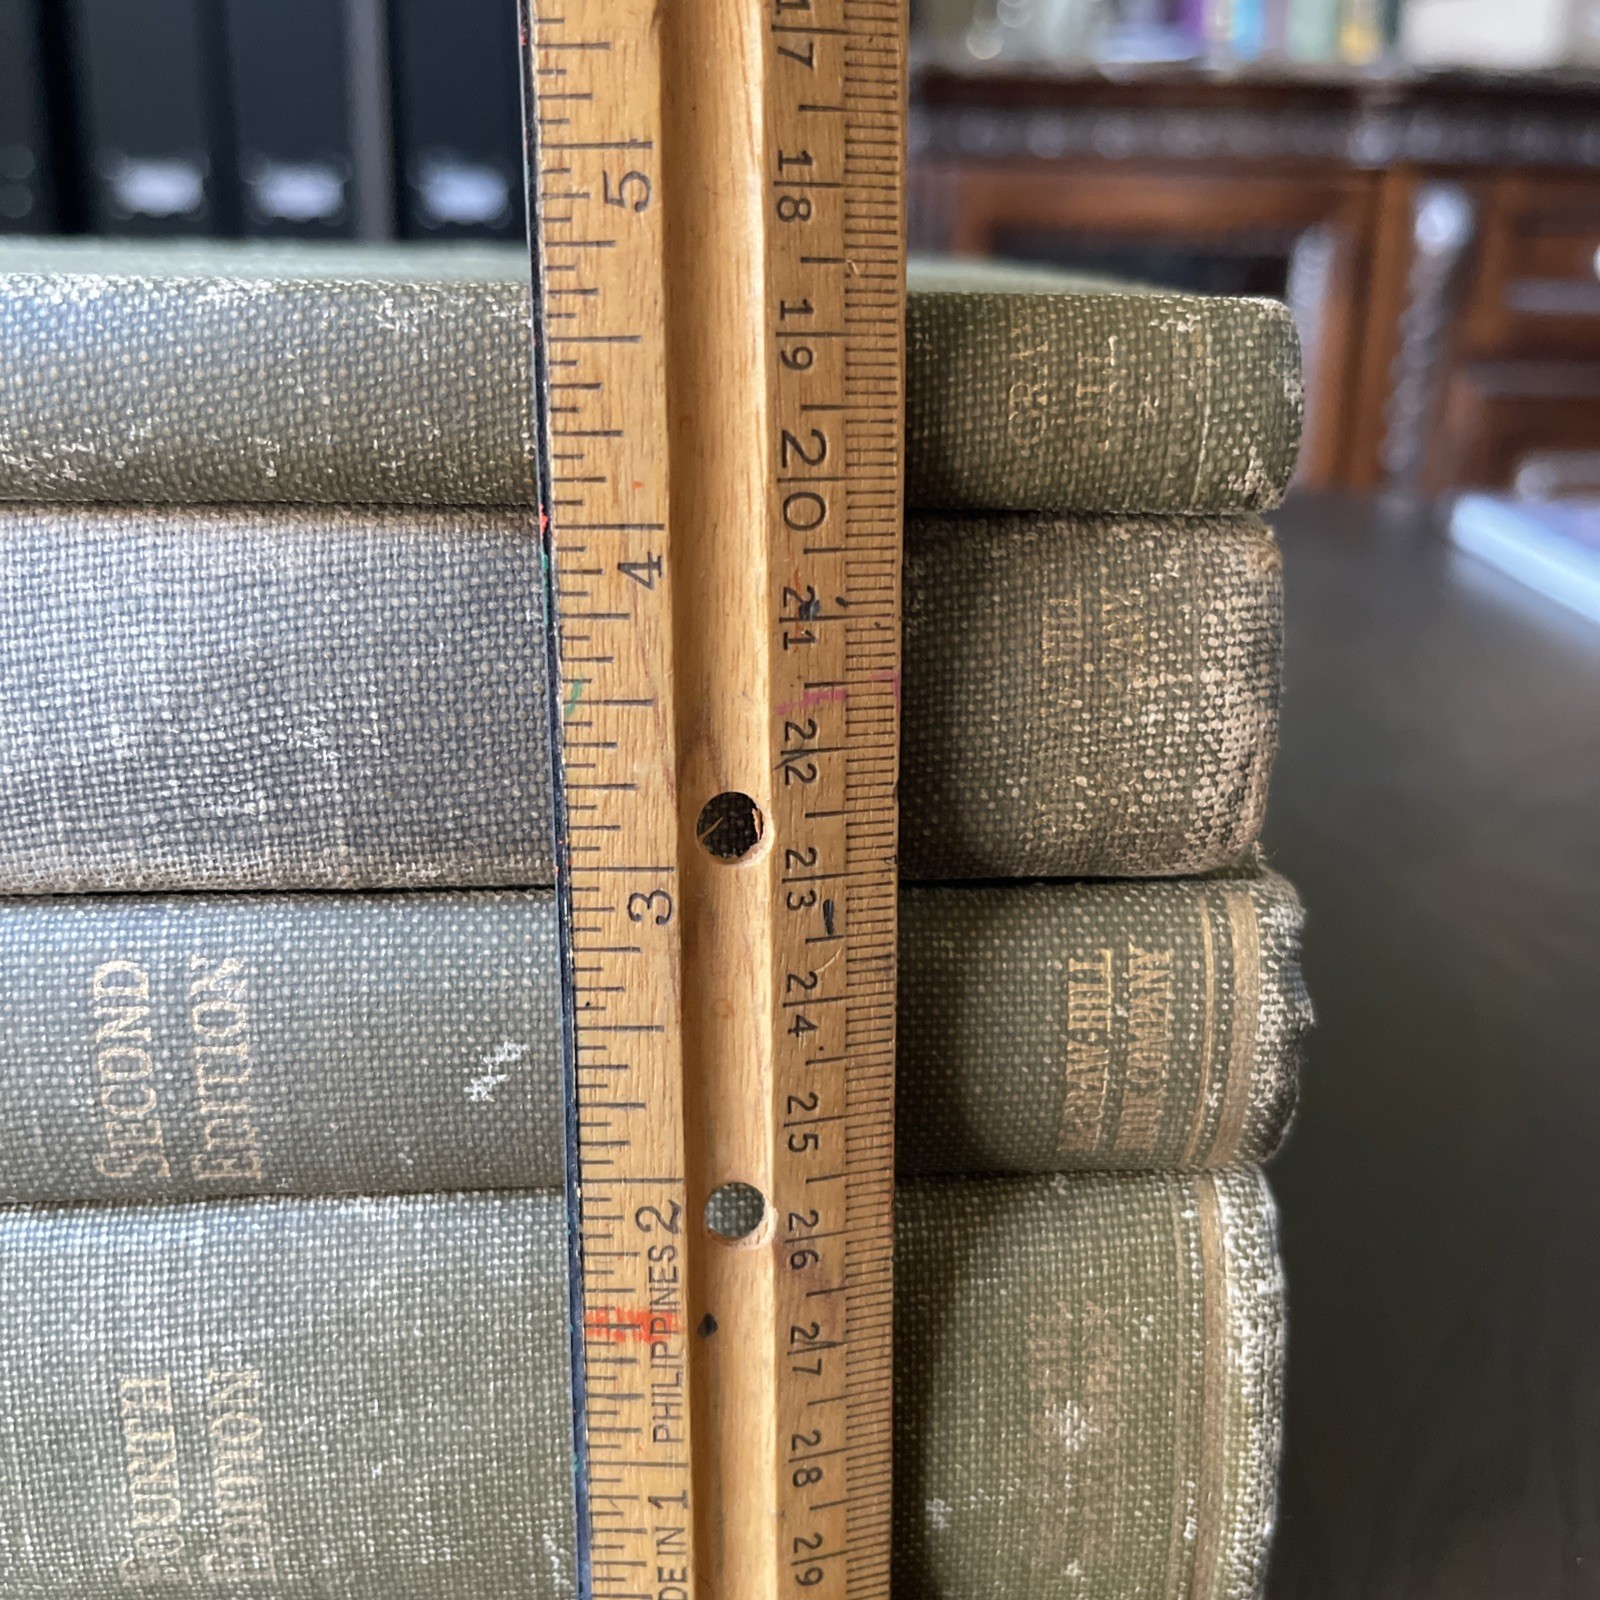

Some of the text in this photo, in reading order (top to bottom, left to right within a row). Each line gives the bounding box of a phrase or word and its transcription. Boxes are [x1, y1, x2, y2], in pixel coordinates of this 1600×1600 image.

[602, 170, 653, 213] 5
[776, 149, 814, 224] 18
[779, 298, 815, 371] 19
[781, 428, 828, 532] 20
[617, 550, 663, 591] 4
[783, 585, 820, 651] 21
[783, 718, 819, 787] 22
[626, 888, 673, 926] 3
[784, 846, 819, 912] 23
[785, 970, 820, 1041] 24
[786, 1092, 820, 1154] 25
[634, 1198, 683, 1235] 2
[788, 1209, 820, 1272] 26
[647, 1243, 684, 1445] PHILIPPINES
[789, 1321, 823, 1377] 27
[790, 1429, 824, 1489] 28
[647, 1488, 689, 1511] 1
[655, 1526, 687, 1559] IN
[792, 1531, 825, 1588] 29
